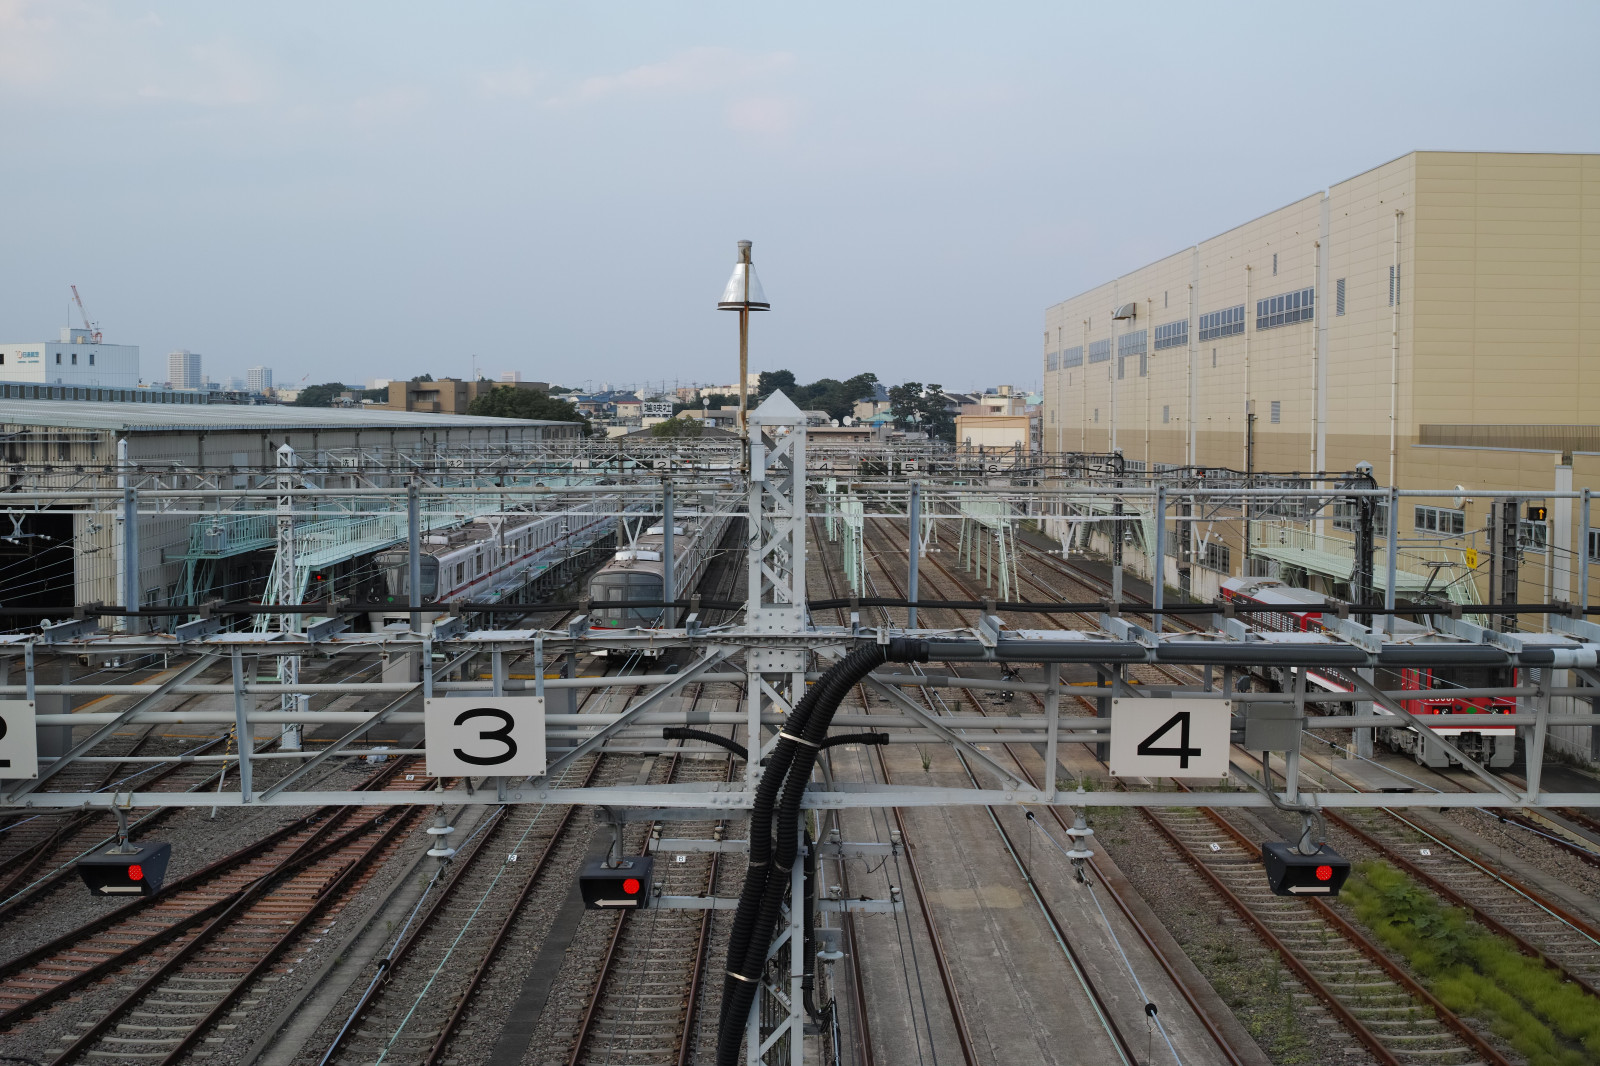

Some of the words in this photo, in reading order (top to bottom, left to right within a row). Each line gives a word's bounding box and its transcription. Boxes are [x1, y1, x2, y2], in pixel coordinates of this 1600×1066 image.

[905, 463, 915, 473] 5
[988, 464, 998, 473] 6
[1092, 465, 1103, 475] 7
[453, 707, 518, 766] 3
[1137, 711, 1202, 769] 4
